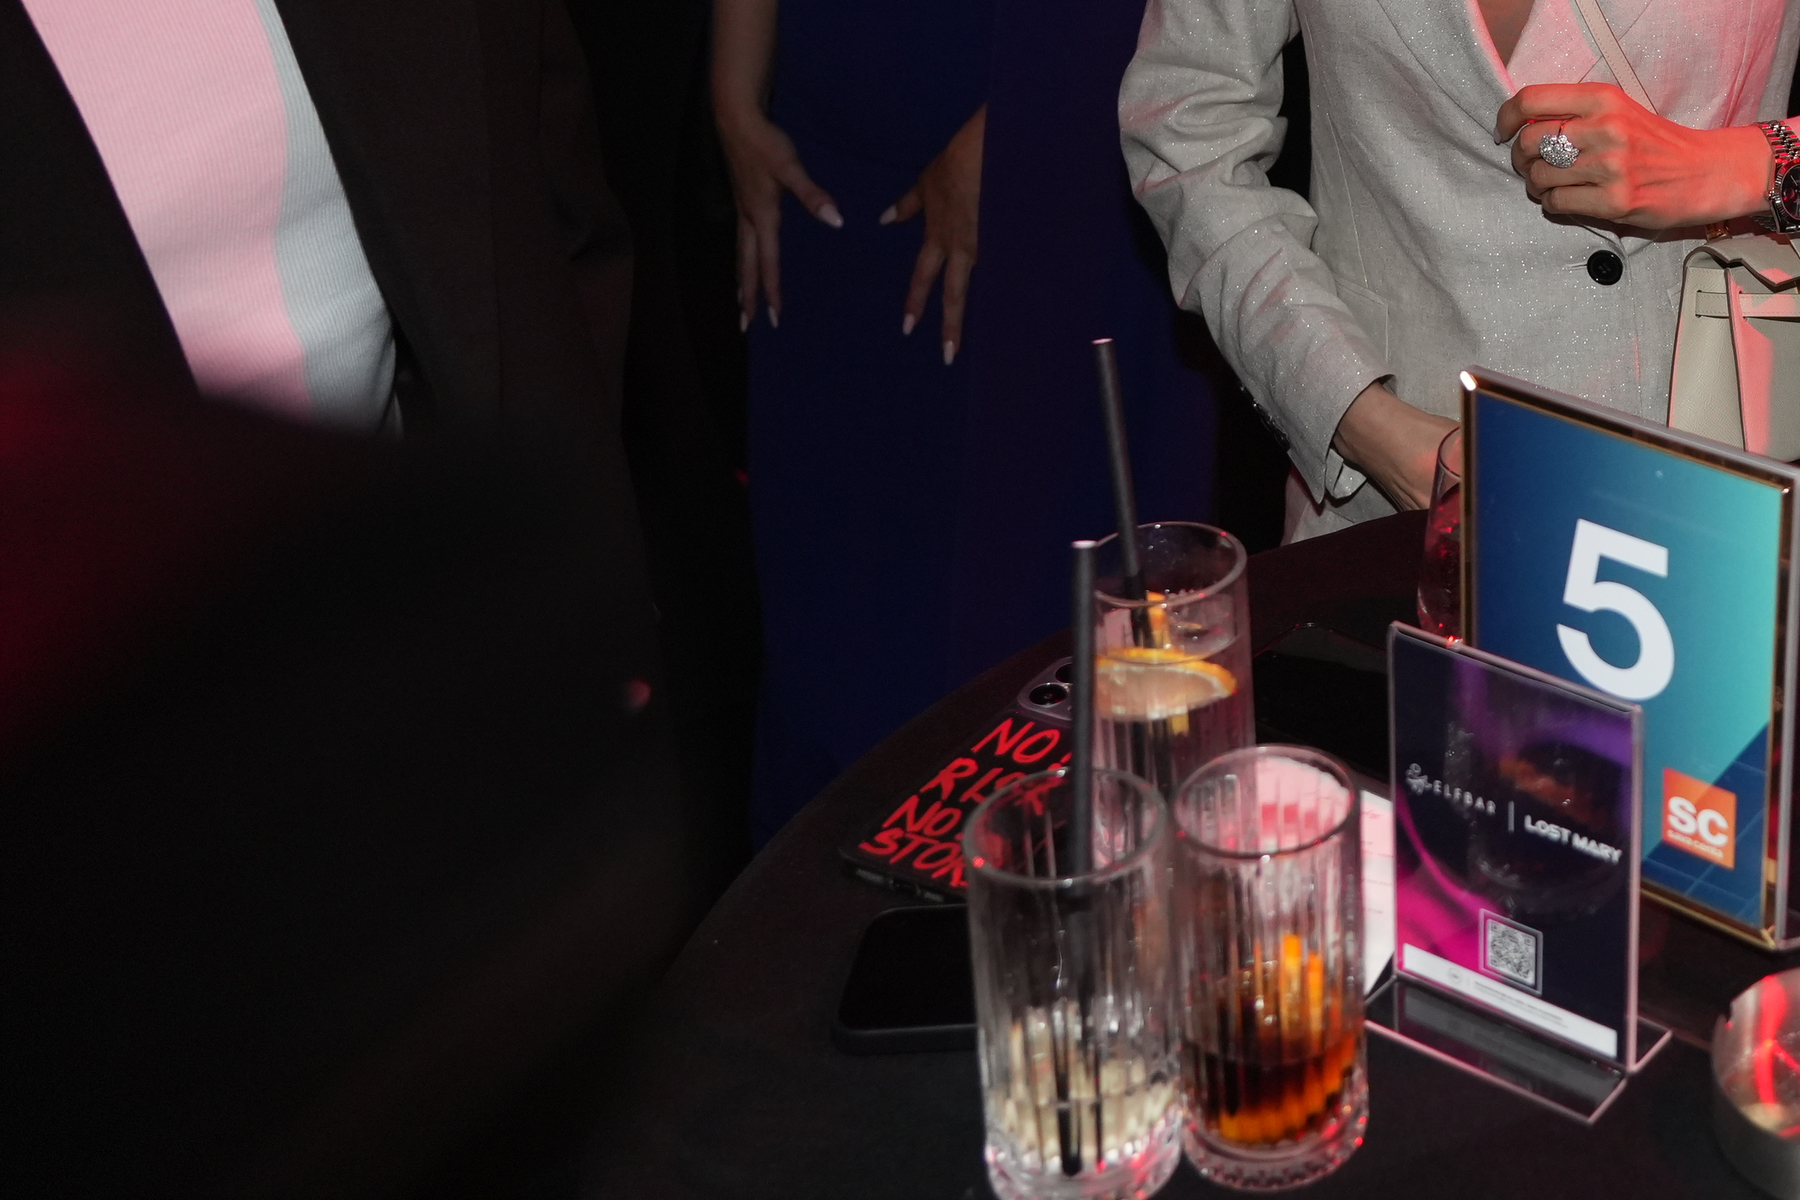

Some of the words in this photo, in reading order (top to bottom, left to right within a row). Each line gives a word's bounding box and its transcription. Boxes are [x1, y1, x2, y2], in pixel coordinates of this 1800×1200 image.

[1556, 518, 1675, 700] 5
[1523, 814, 1571, 845] LOST
[1571, 833, 1623, 865] MARY
[1667, 796, 1729, 847] SC
